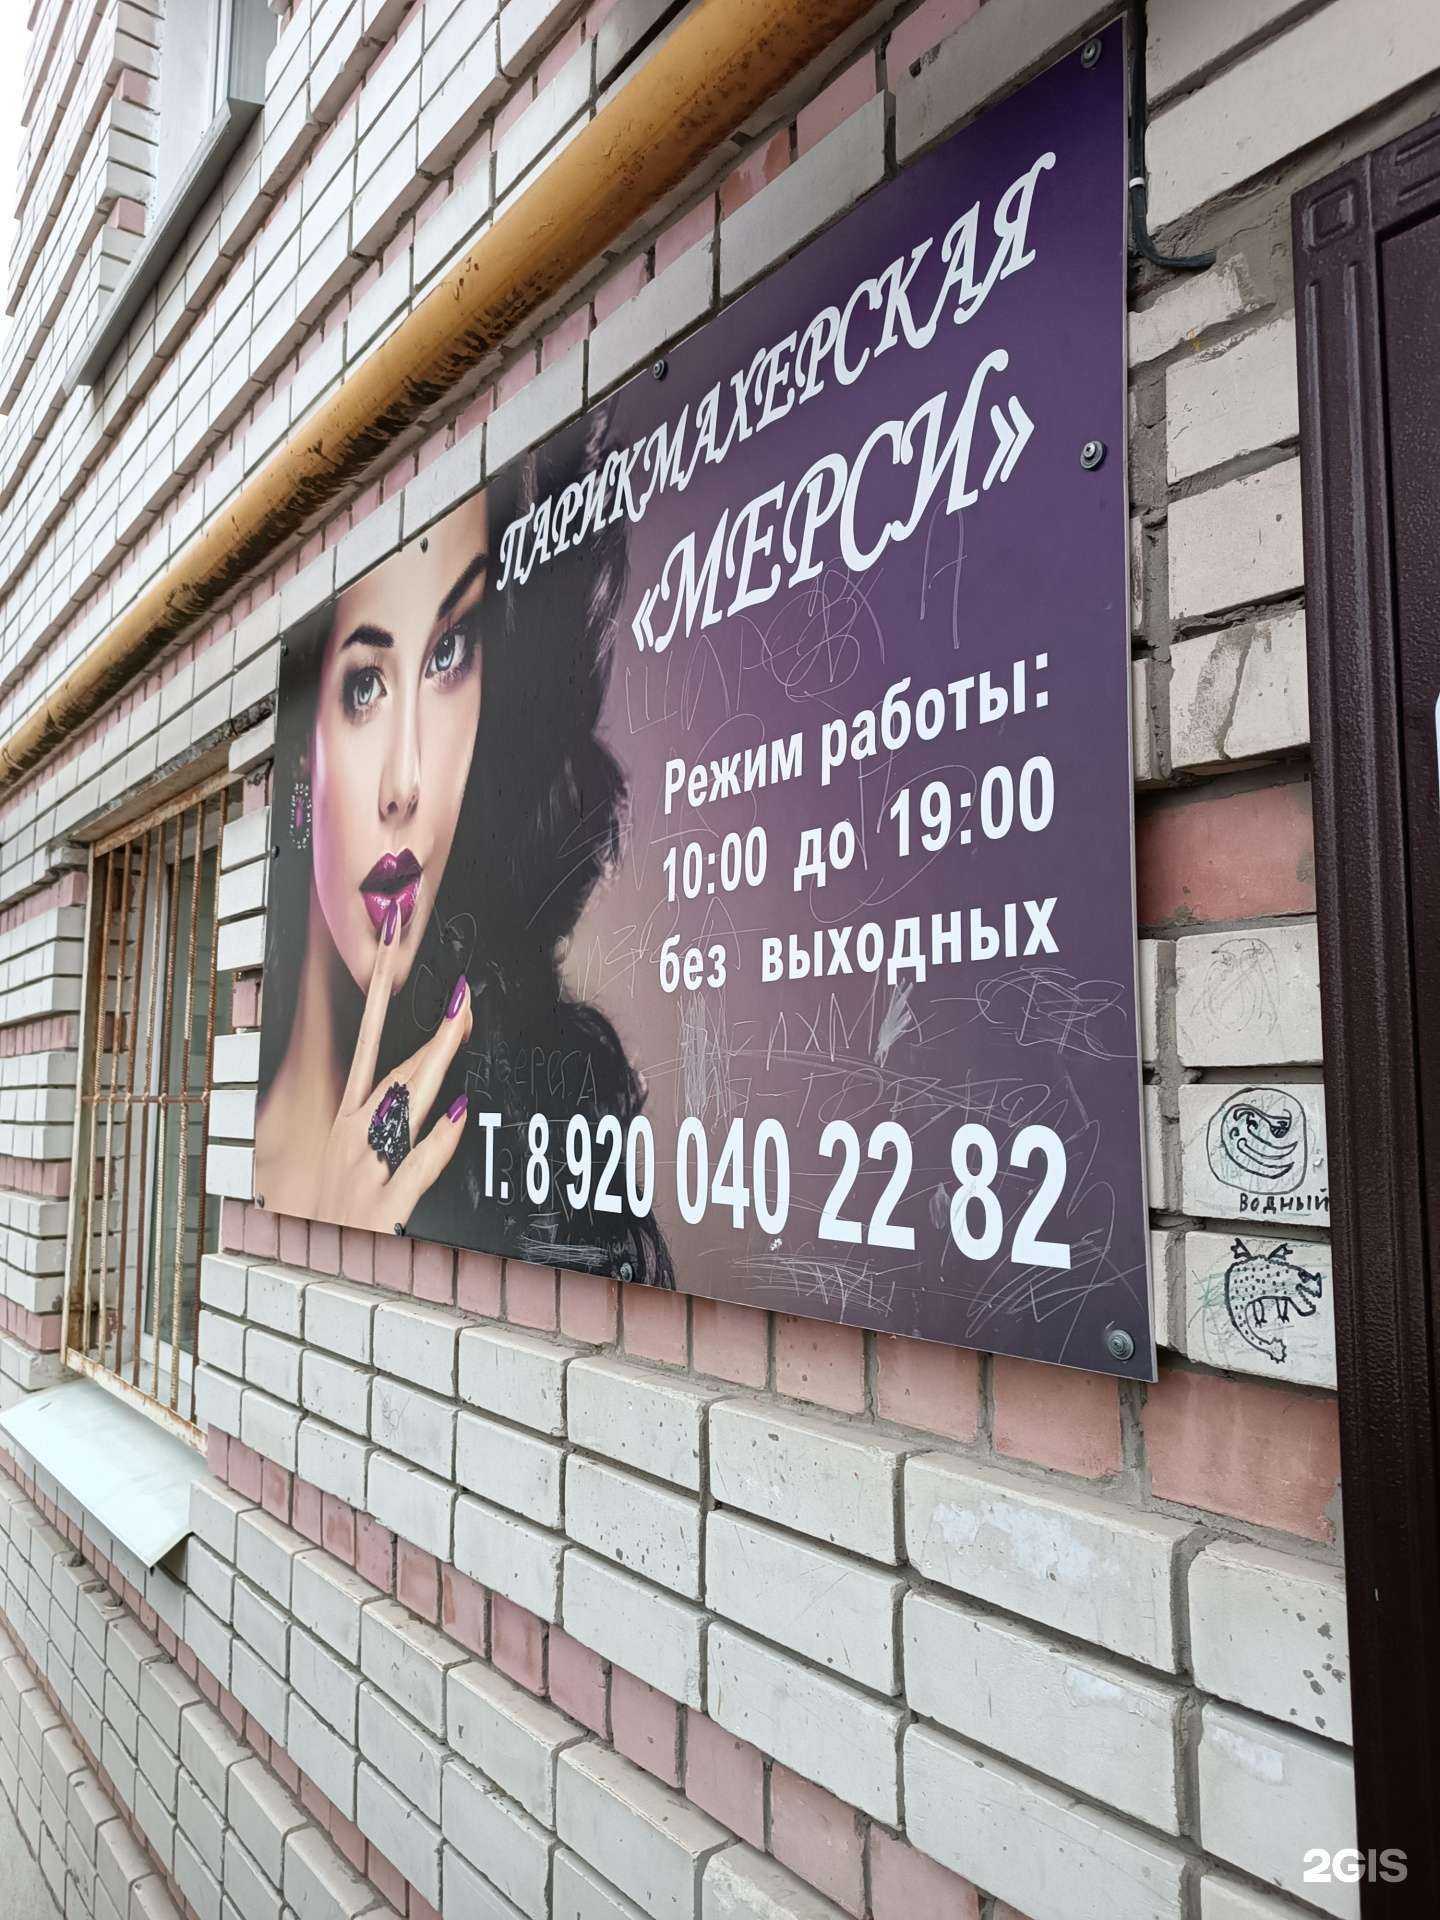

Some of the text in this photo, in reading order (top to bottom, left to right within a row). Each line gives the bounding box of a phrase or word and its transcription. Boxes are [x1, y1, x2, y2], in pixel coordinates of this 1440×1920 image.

[496, 152, 1056, 590] ПАРИКМАХЕРСКАЯ
[631, 349, 1035, 653] «МЕРСИ»
[663, 732, 804, 815] Режим
[821, 652, 1049, 786] работы:
[662, 755, 1055, 902] 10:00 до 19:00
[659, 897, 1060, 993] без выходных
[478, 1112, 1071, 1270] Т. 8 920 040 22 82
